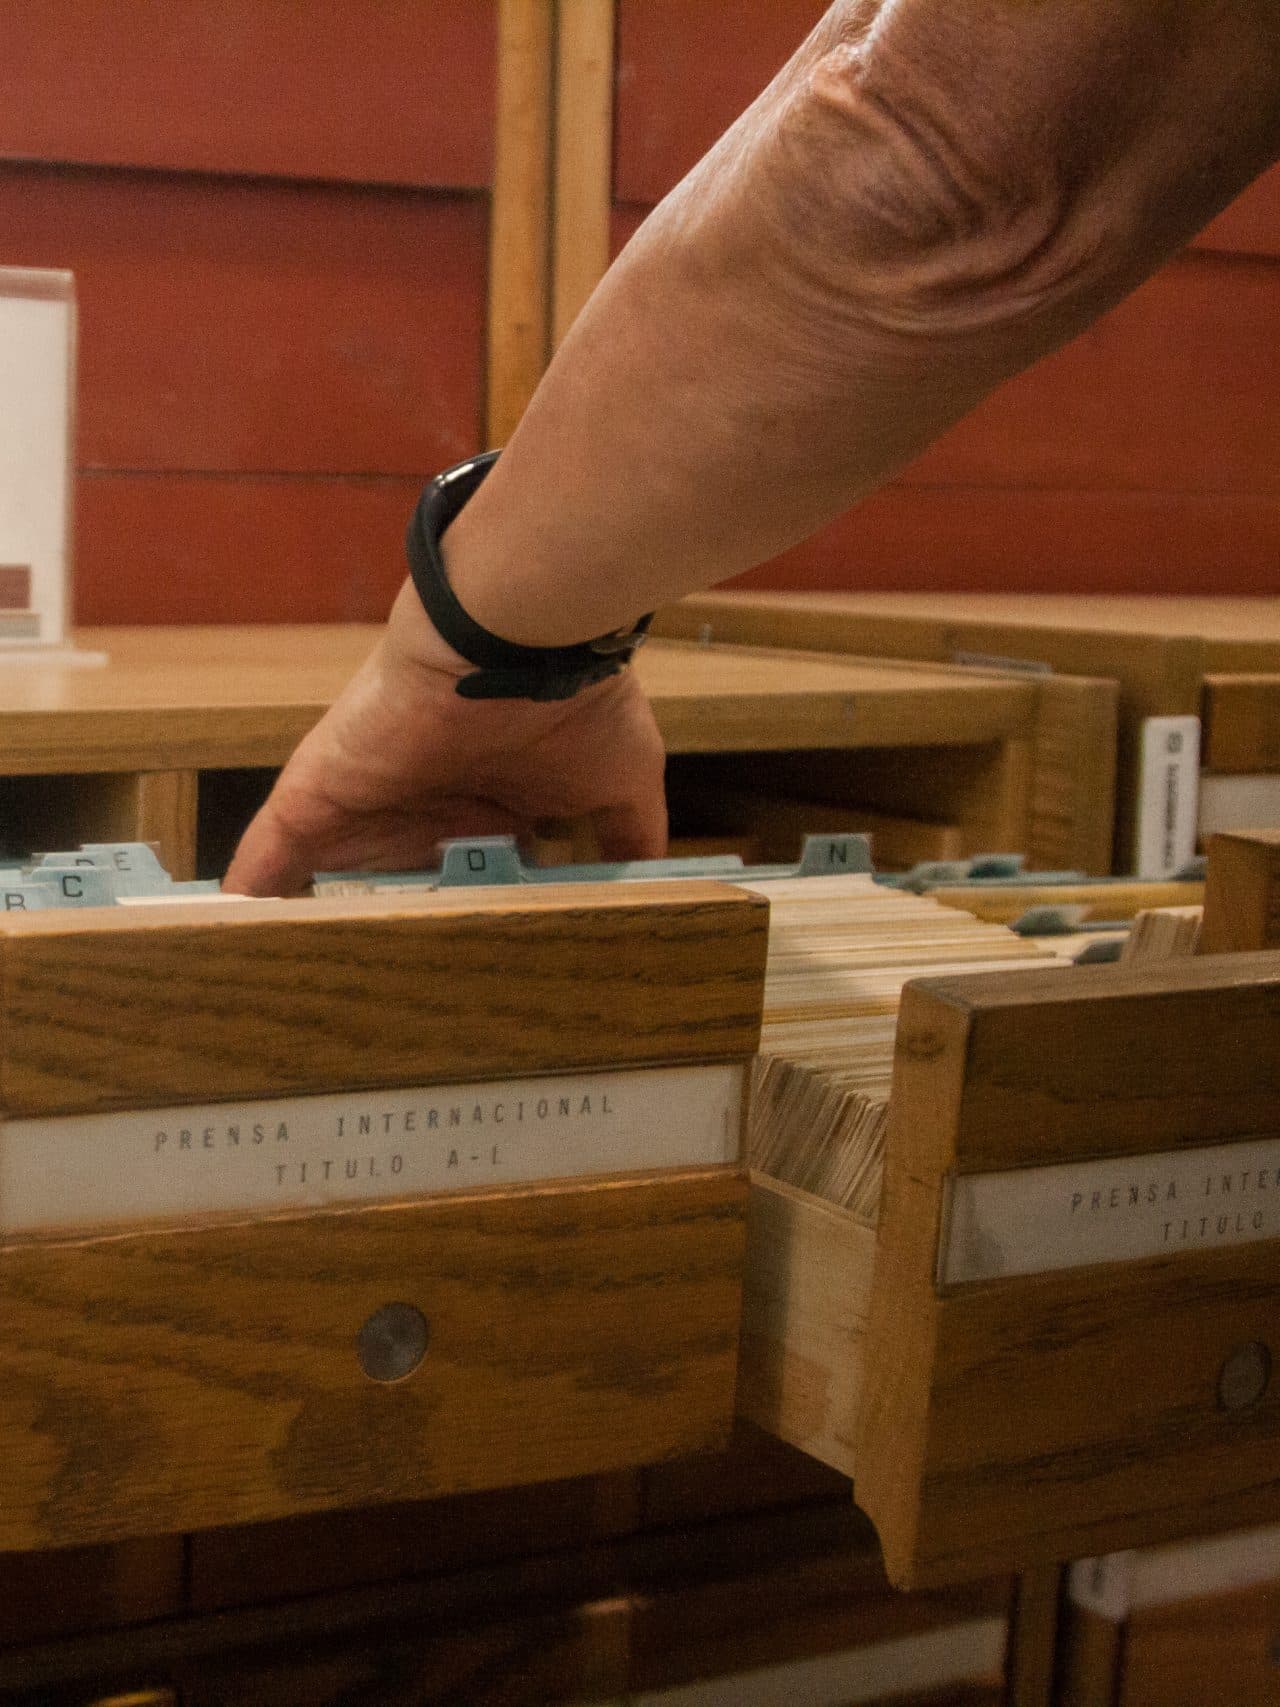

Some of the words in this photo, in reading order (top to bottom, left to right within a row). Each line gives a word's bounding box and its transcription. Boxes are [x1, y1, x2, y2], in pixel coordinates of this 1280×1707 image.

[115, 851, 131, 871] E
[830, 844, 847, 864] N
[62, 875, 83, 898] C
[154, 1122, 290, 1152] PRENSA
[336, 1094, 616, 1138] INTERNACIONAL
[274, 1155, 404, 1187] TITULO
[447, 1145, 504, 1170] A-L
[1072, 1181, 1177, 1213] PRENSA
[1161, 1209, 1265, 1240] TITULO
